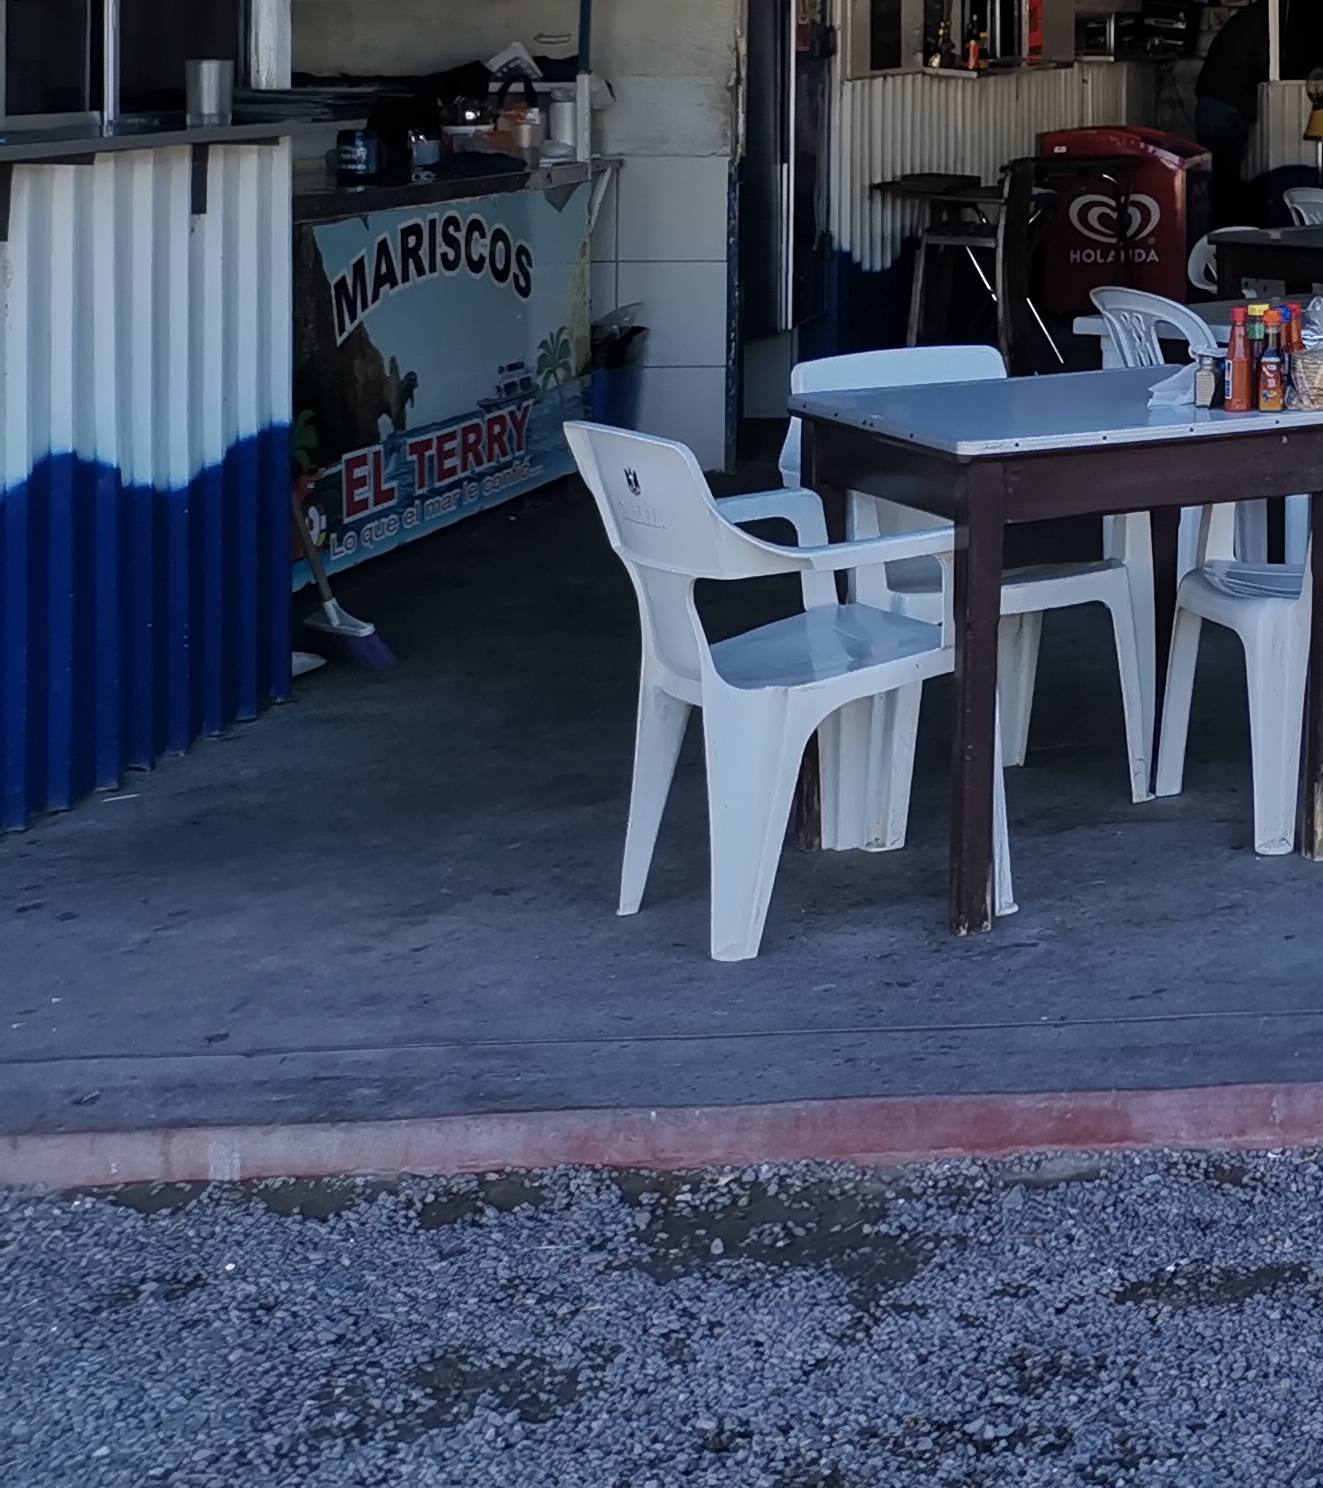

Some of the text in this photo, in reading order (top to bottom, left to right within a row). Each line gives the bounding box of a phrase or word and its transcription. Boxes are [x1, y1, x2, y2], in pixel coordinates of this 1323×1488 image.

[333, 214, 534, 338] MARISCOS
[343, 403, 532, 519] EL TERRY
[330, 532, 358, 560] Lo
[361, 514, 399, 548] que
[402, 499, 420, 528] el
[424, 488, 461, 519] mar
